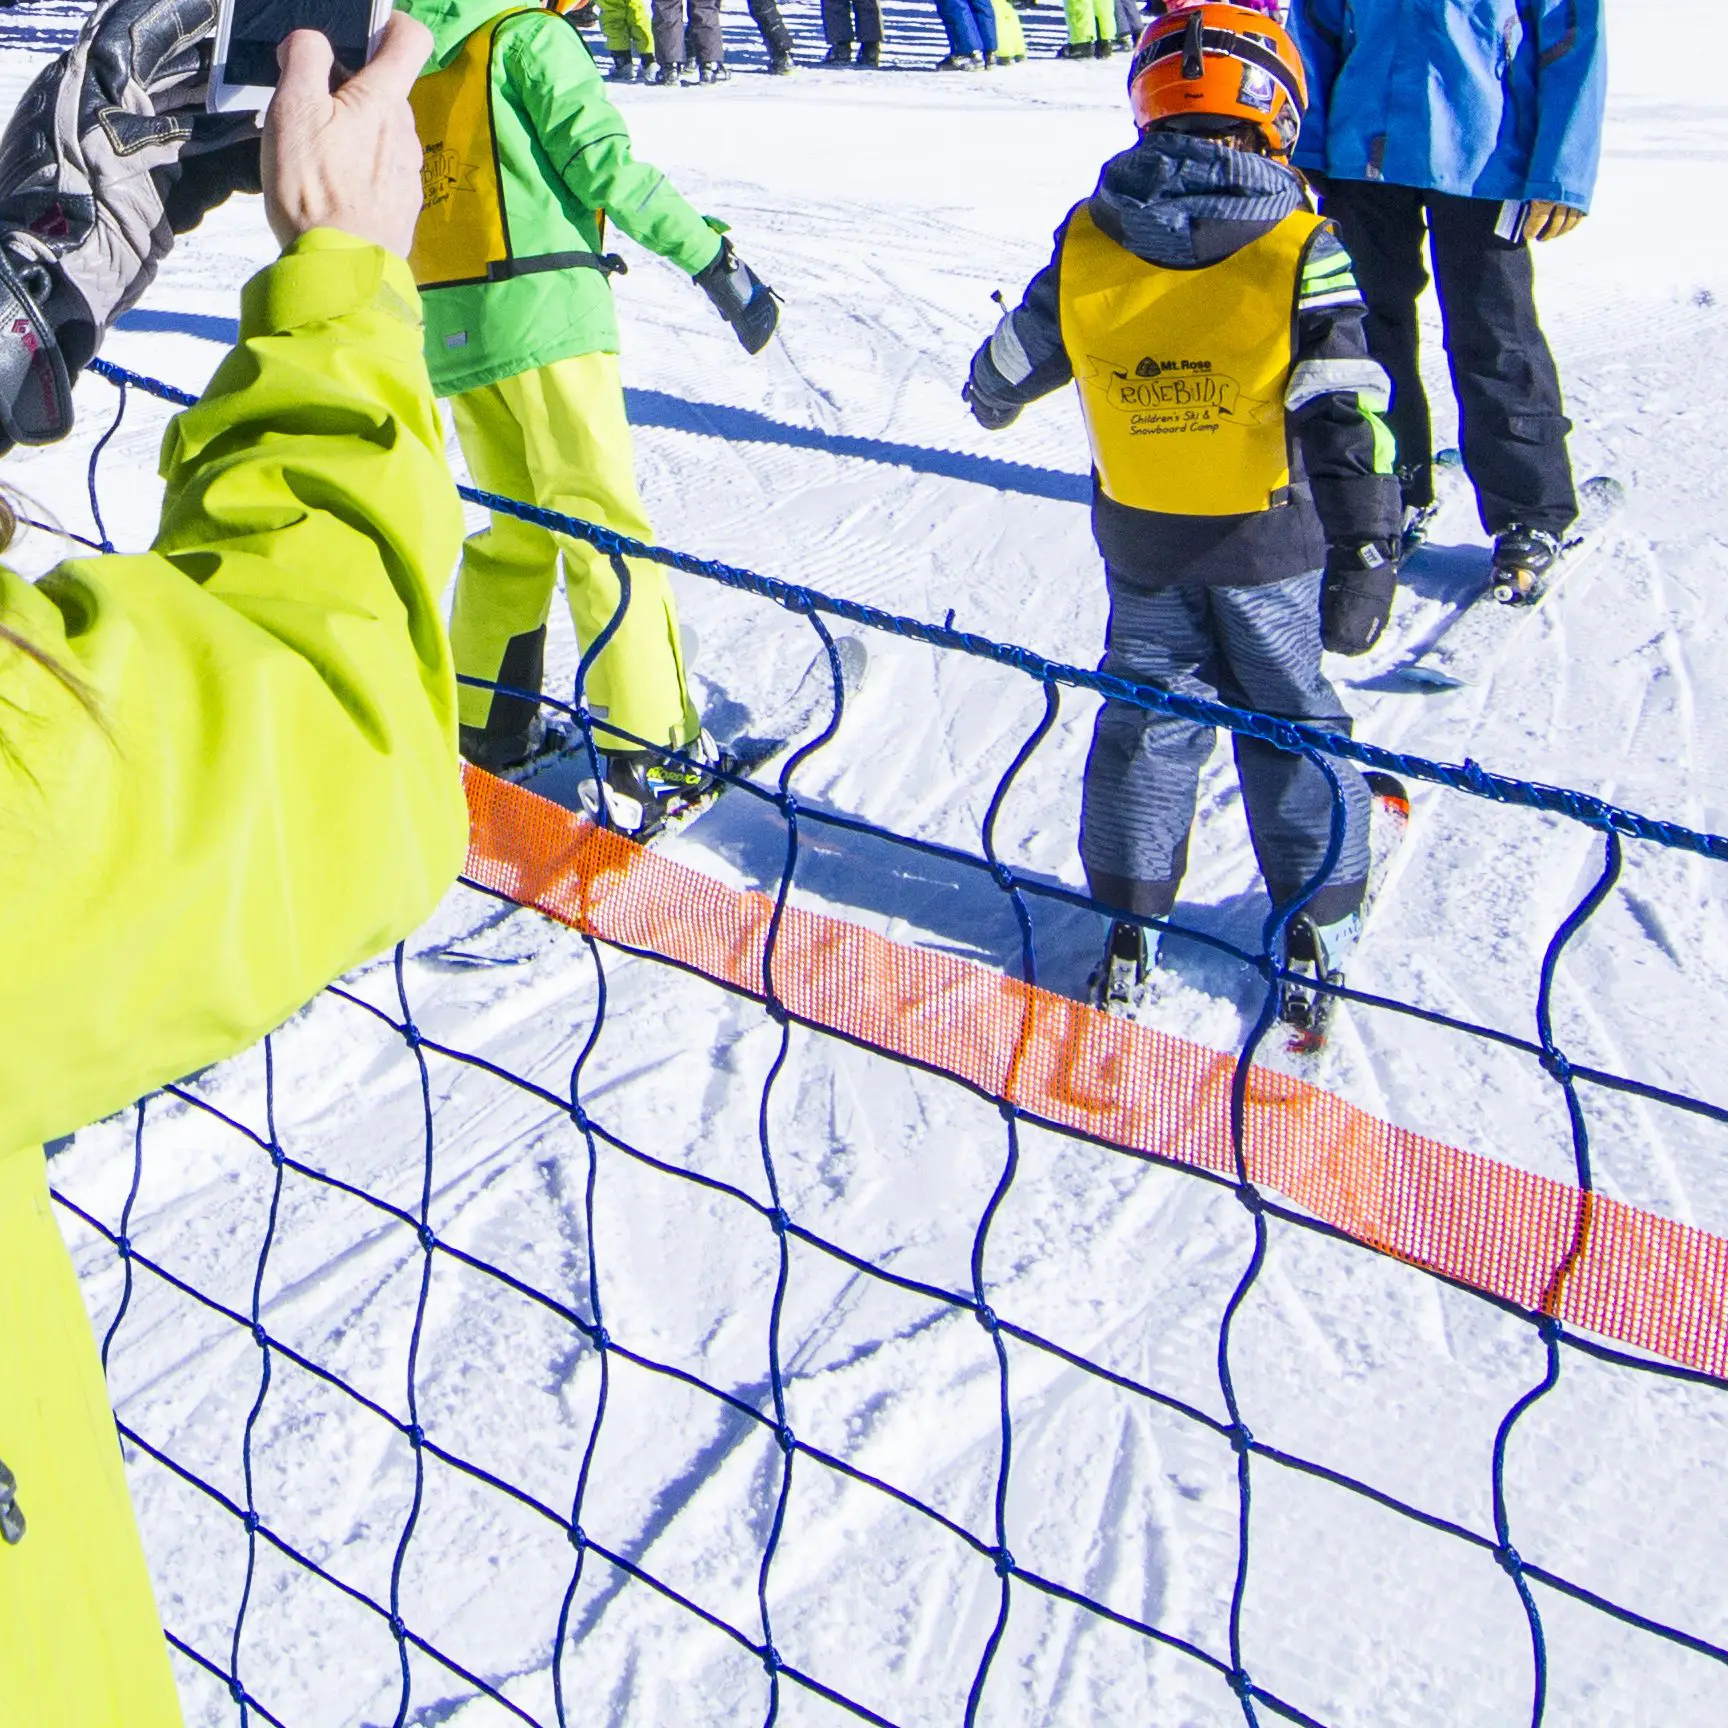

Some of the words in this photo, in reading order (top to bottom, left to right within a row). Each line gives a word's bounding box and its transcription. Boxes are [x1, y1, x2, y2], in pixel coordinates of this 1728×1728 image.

[1160, 360, 1179, 372] Mt.
[1181, 359, 1212, 370] Rose
[1120, 377, 1229, 408] ROSEBUDS
[1130, 411, 1180, 424] Children's
[1183, 410, 1200, 422] Ski
[1203, 410, 1211, 420] &
[1130, 423, 1188, 436] Snowboard
[1190, 422, 1219, 435] Camp
